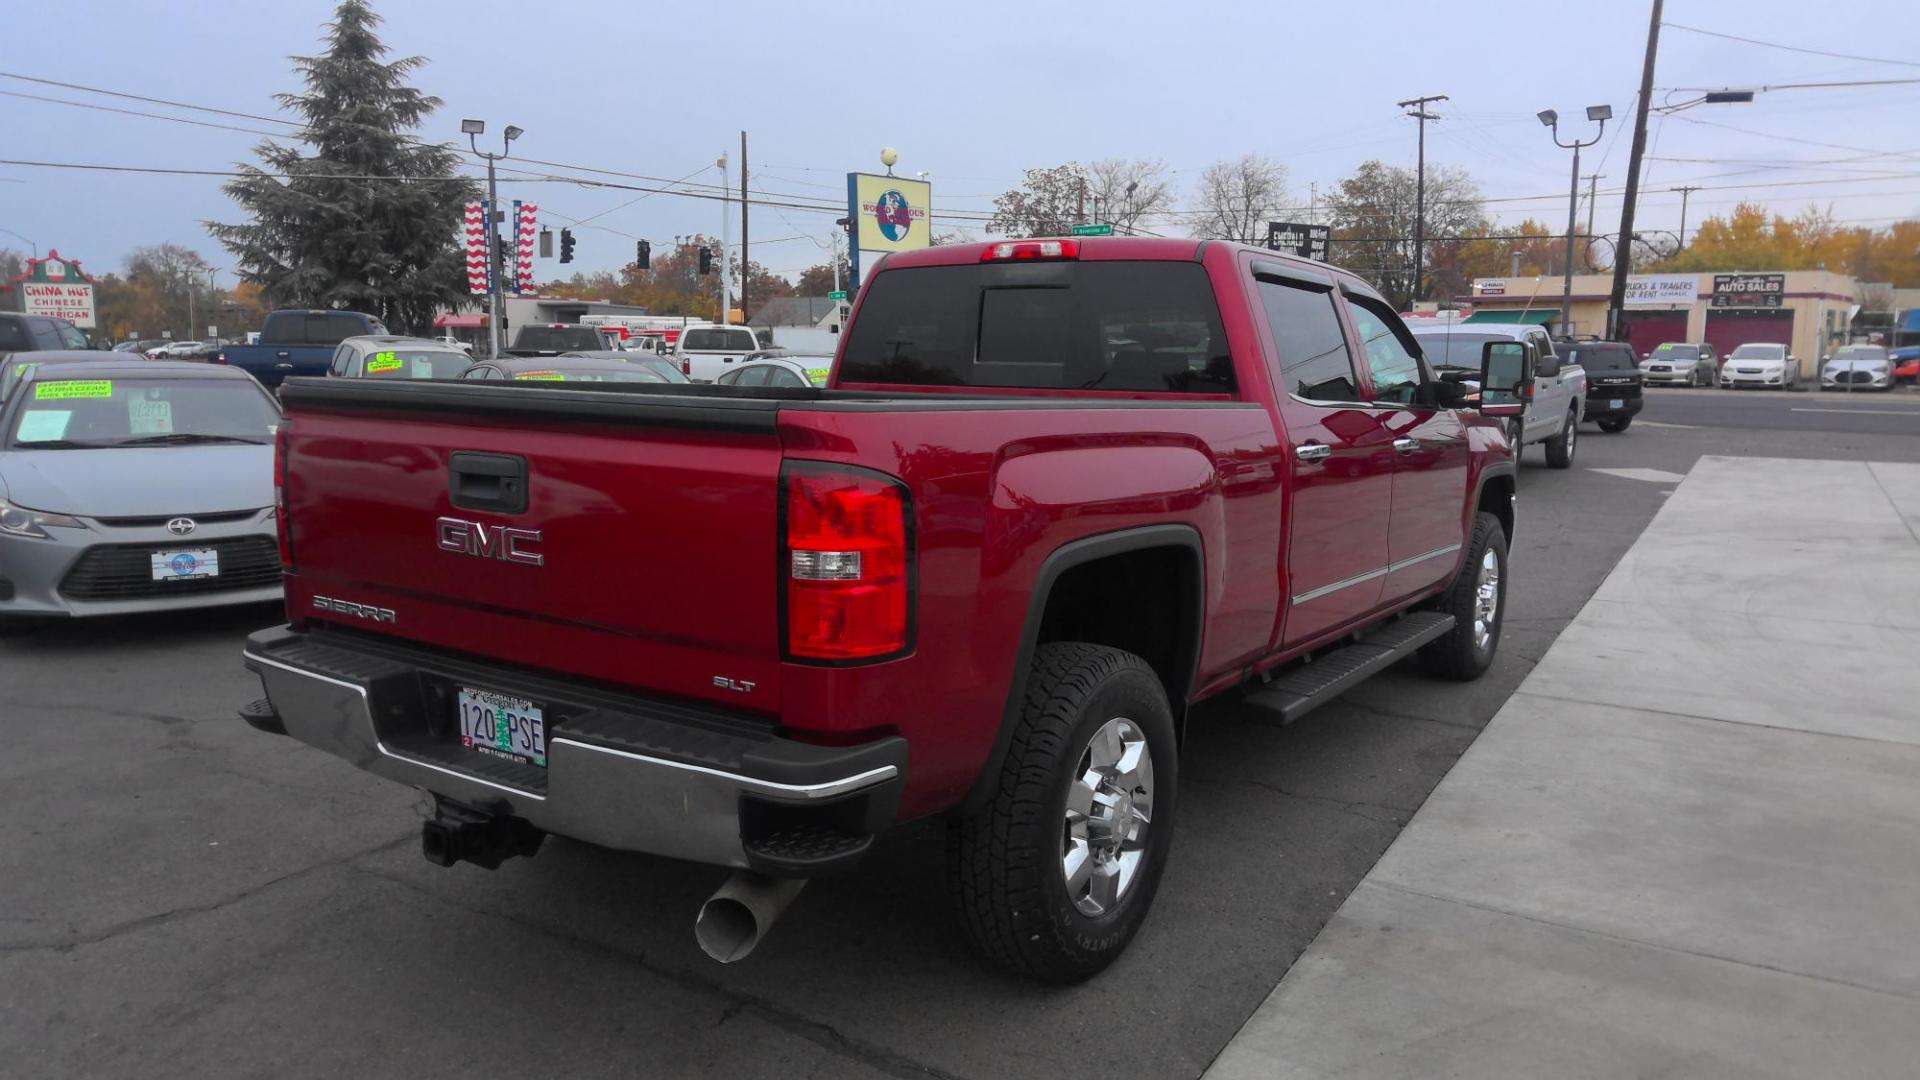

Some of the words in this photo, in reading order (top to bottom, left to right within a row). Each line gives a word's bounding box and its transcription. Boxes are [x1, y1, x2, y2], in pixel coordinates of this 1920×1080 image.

[1273, 231, 1304, 247] EMERALD
[25, 286, 62, 296] CHINA
[67, 288, 90, 297] HUT
[1625, 282, 1648, 291] RUCKS
[1659, 281, 1692, 290] TRAILERS
[1718, 283, 1745, 292] AUTO
[1747, 283, 1779, 292] SALES
[1625, 291, 1637, 299] OR
[1639, 290, 1657, 299] RENT
[436, 516, 544, 567] GMC
[313, 595, 396, 623] SIERRA
[713, 676, 756, 692] SLT
[462, 703, 496, 742] 120
[507, 713, 544, 755] PSE
[463, 737, 471, 747] 2
